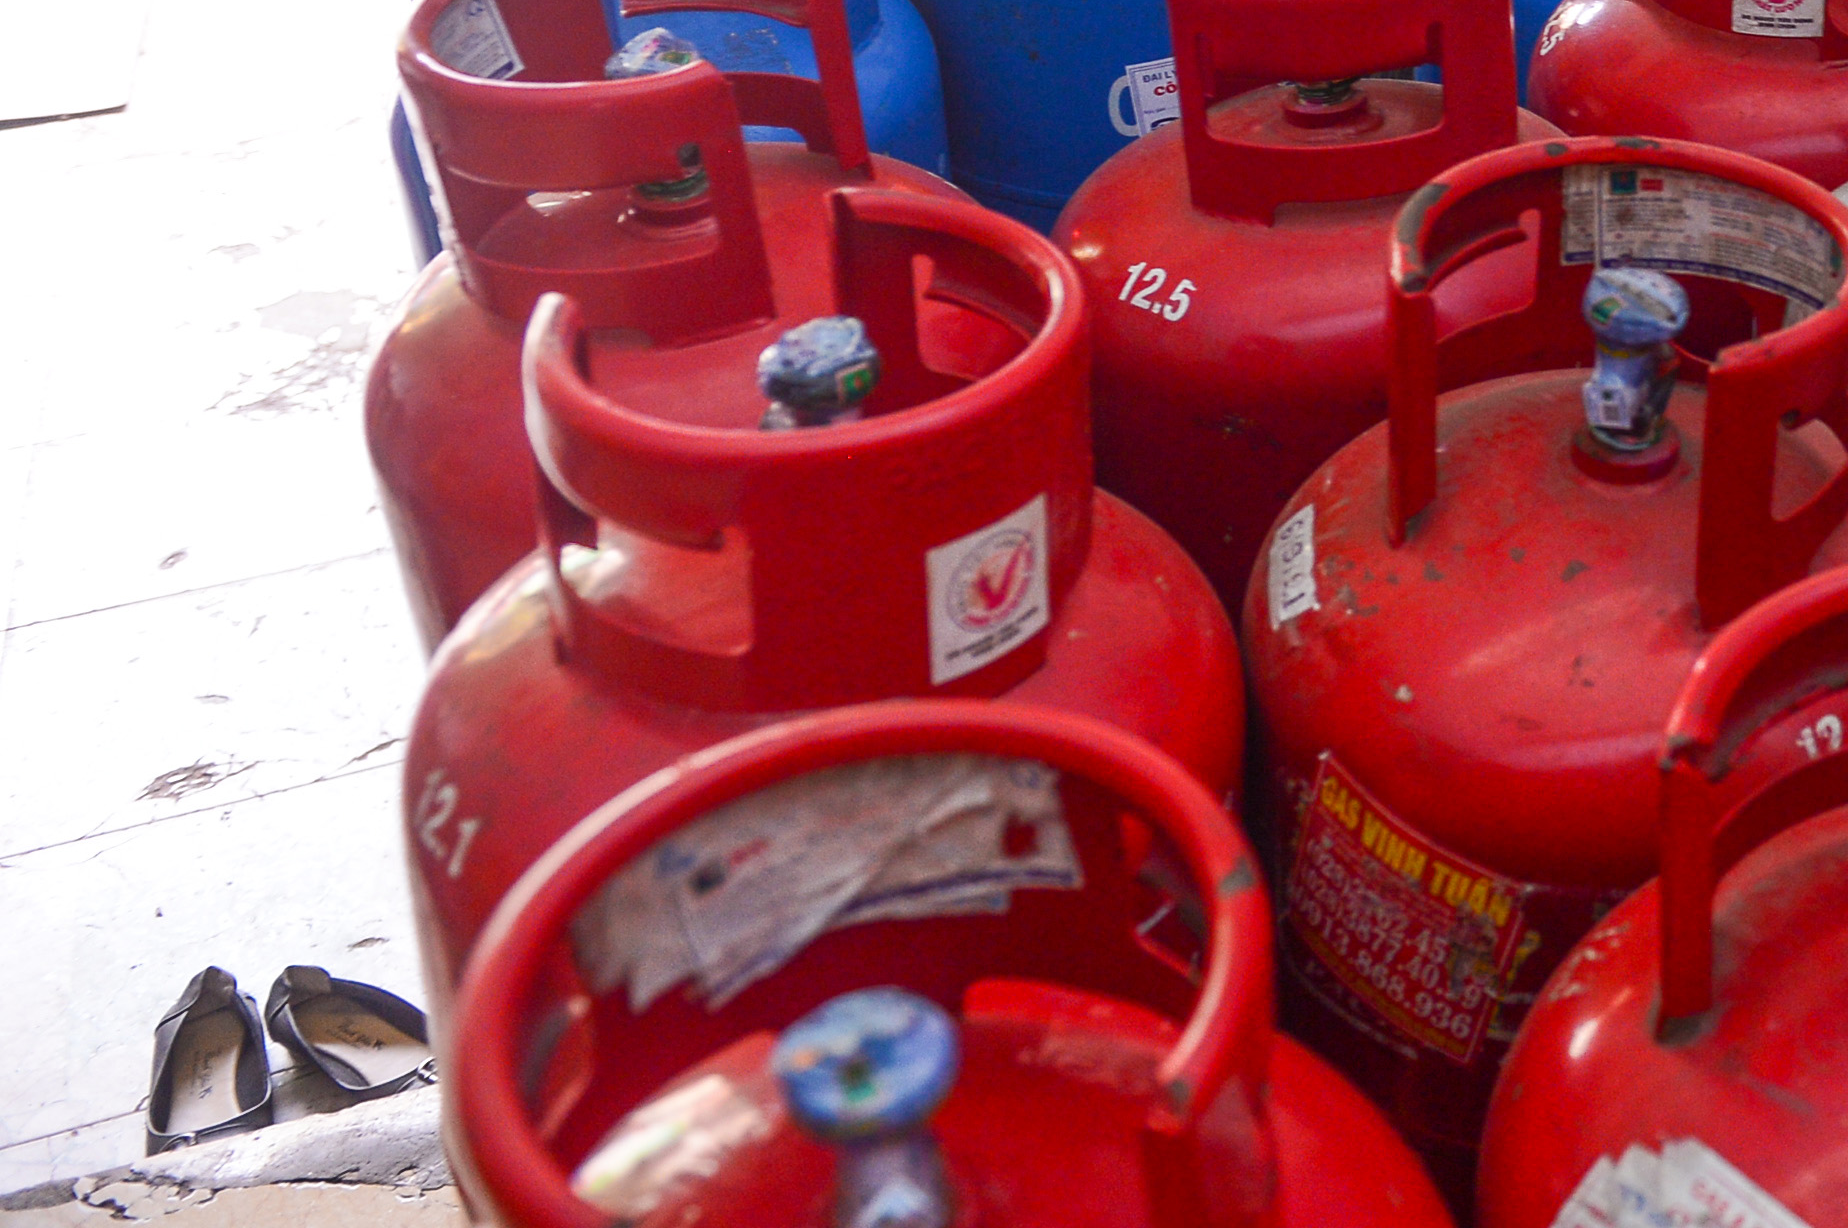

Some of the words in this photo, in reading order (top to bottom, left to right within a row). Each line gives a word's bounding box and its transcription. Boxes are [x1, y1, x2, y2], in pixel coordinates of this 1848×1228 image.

[1118, 261, 1198, 322] 12.5
[1320, 775, 1362, 831] GAS
[1360, 809, 1429, 881] VINH
